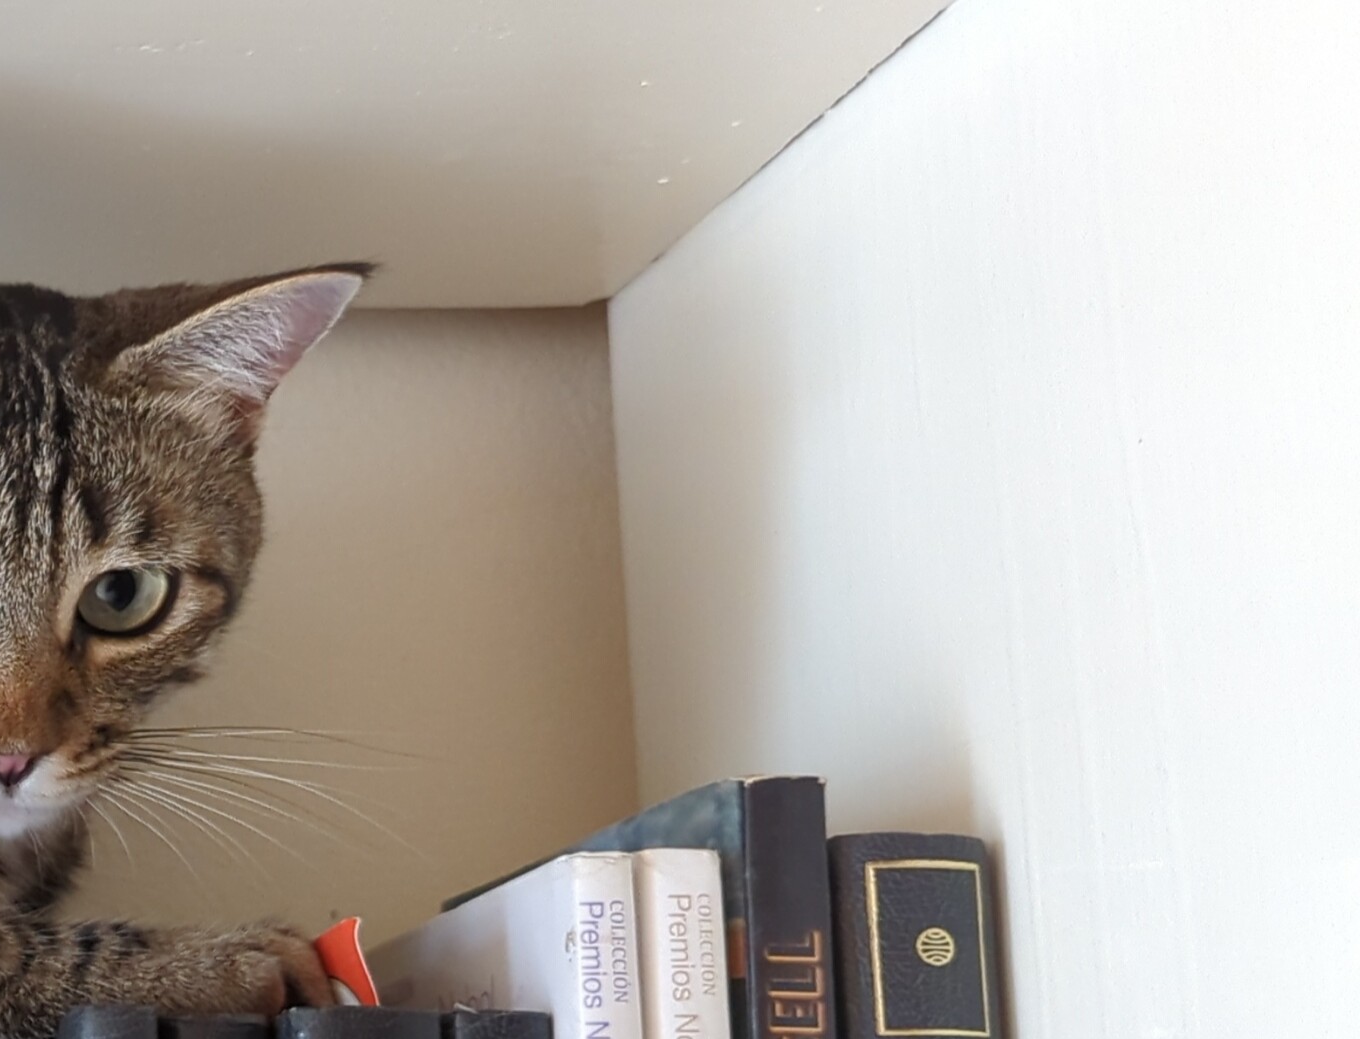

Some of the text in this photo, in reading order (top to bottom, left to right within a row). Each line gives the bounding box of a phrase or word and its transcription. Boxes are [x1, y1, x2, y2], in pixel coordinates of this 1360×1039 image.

[579, 901, 608, 1009] Premios
[610, 900, 630, 1004] COLECCIÓN
[668, 894, 696, 1001] Premios
